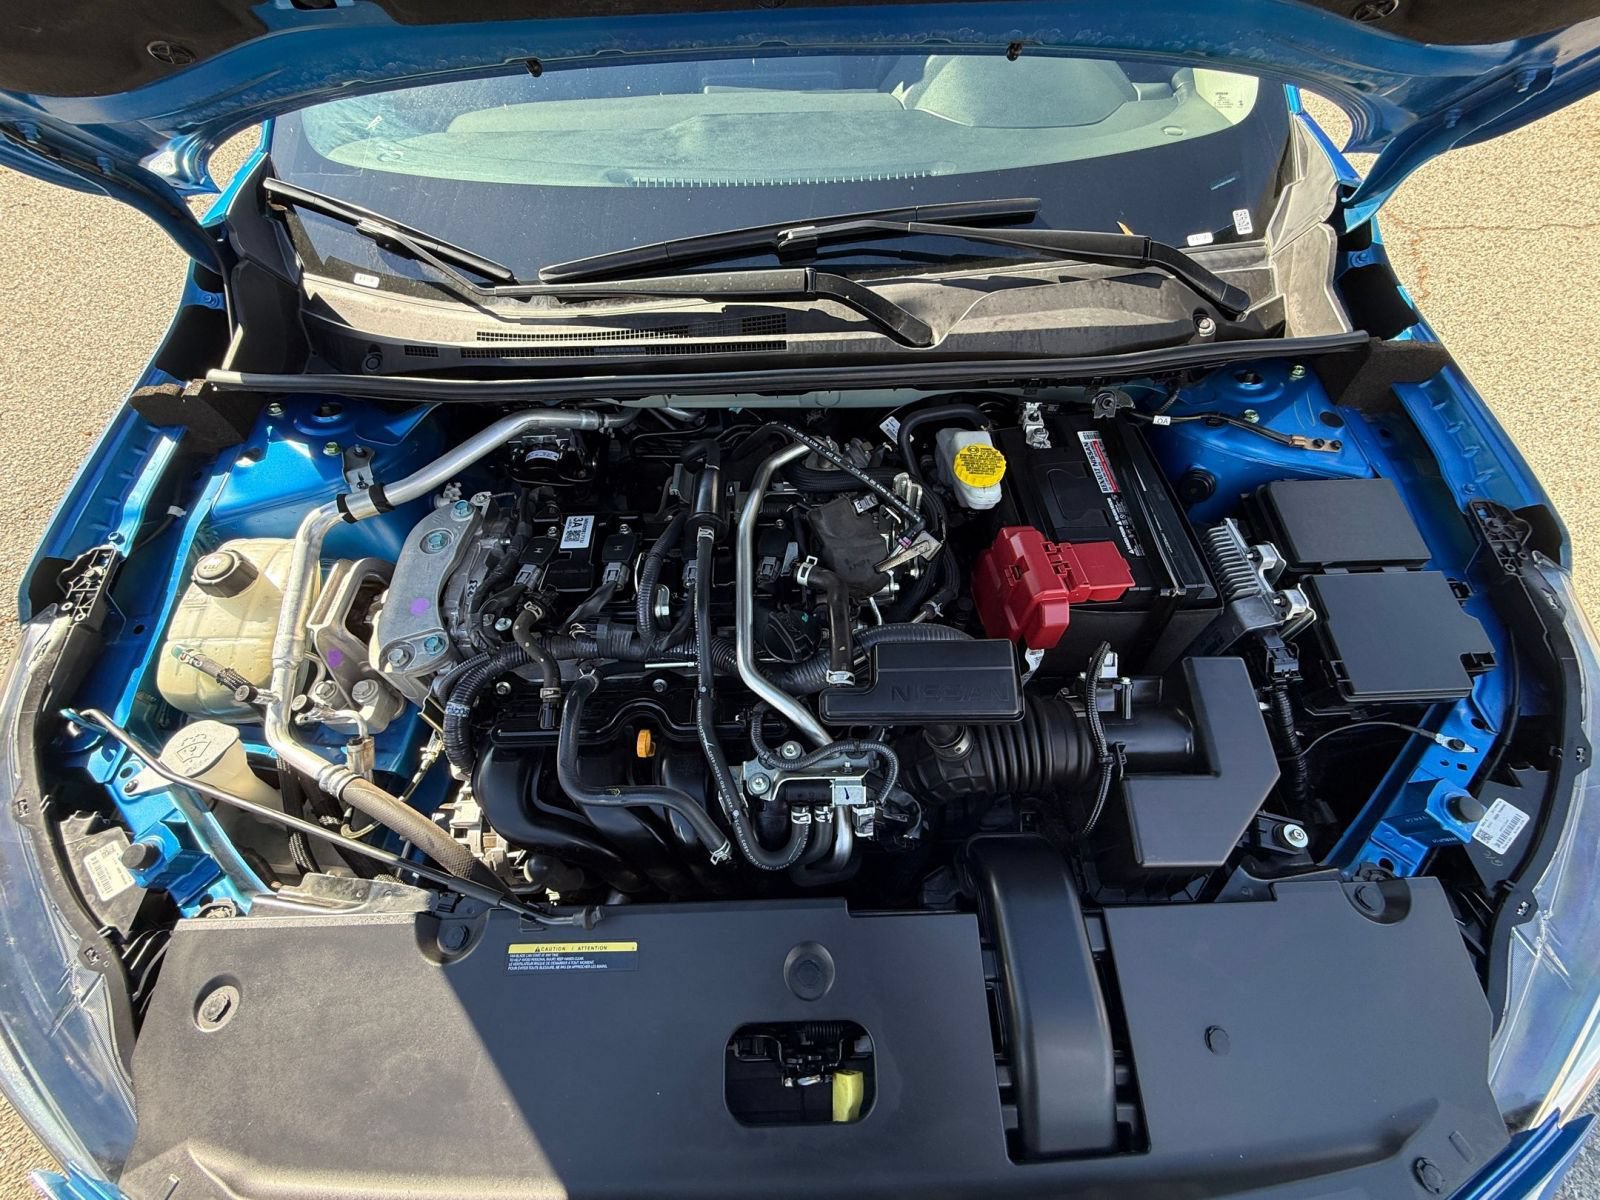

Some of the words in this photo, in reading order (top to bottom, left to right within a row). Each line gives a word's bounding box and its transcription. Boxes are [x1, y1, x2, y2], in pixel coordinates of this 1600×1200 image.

[1083, 441, 1098, 467] NISSAN
[572, 517, 584, 528] 3A
[889, 684, 1009, 702] NISSAN
